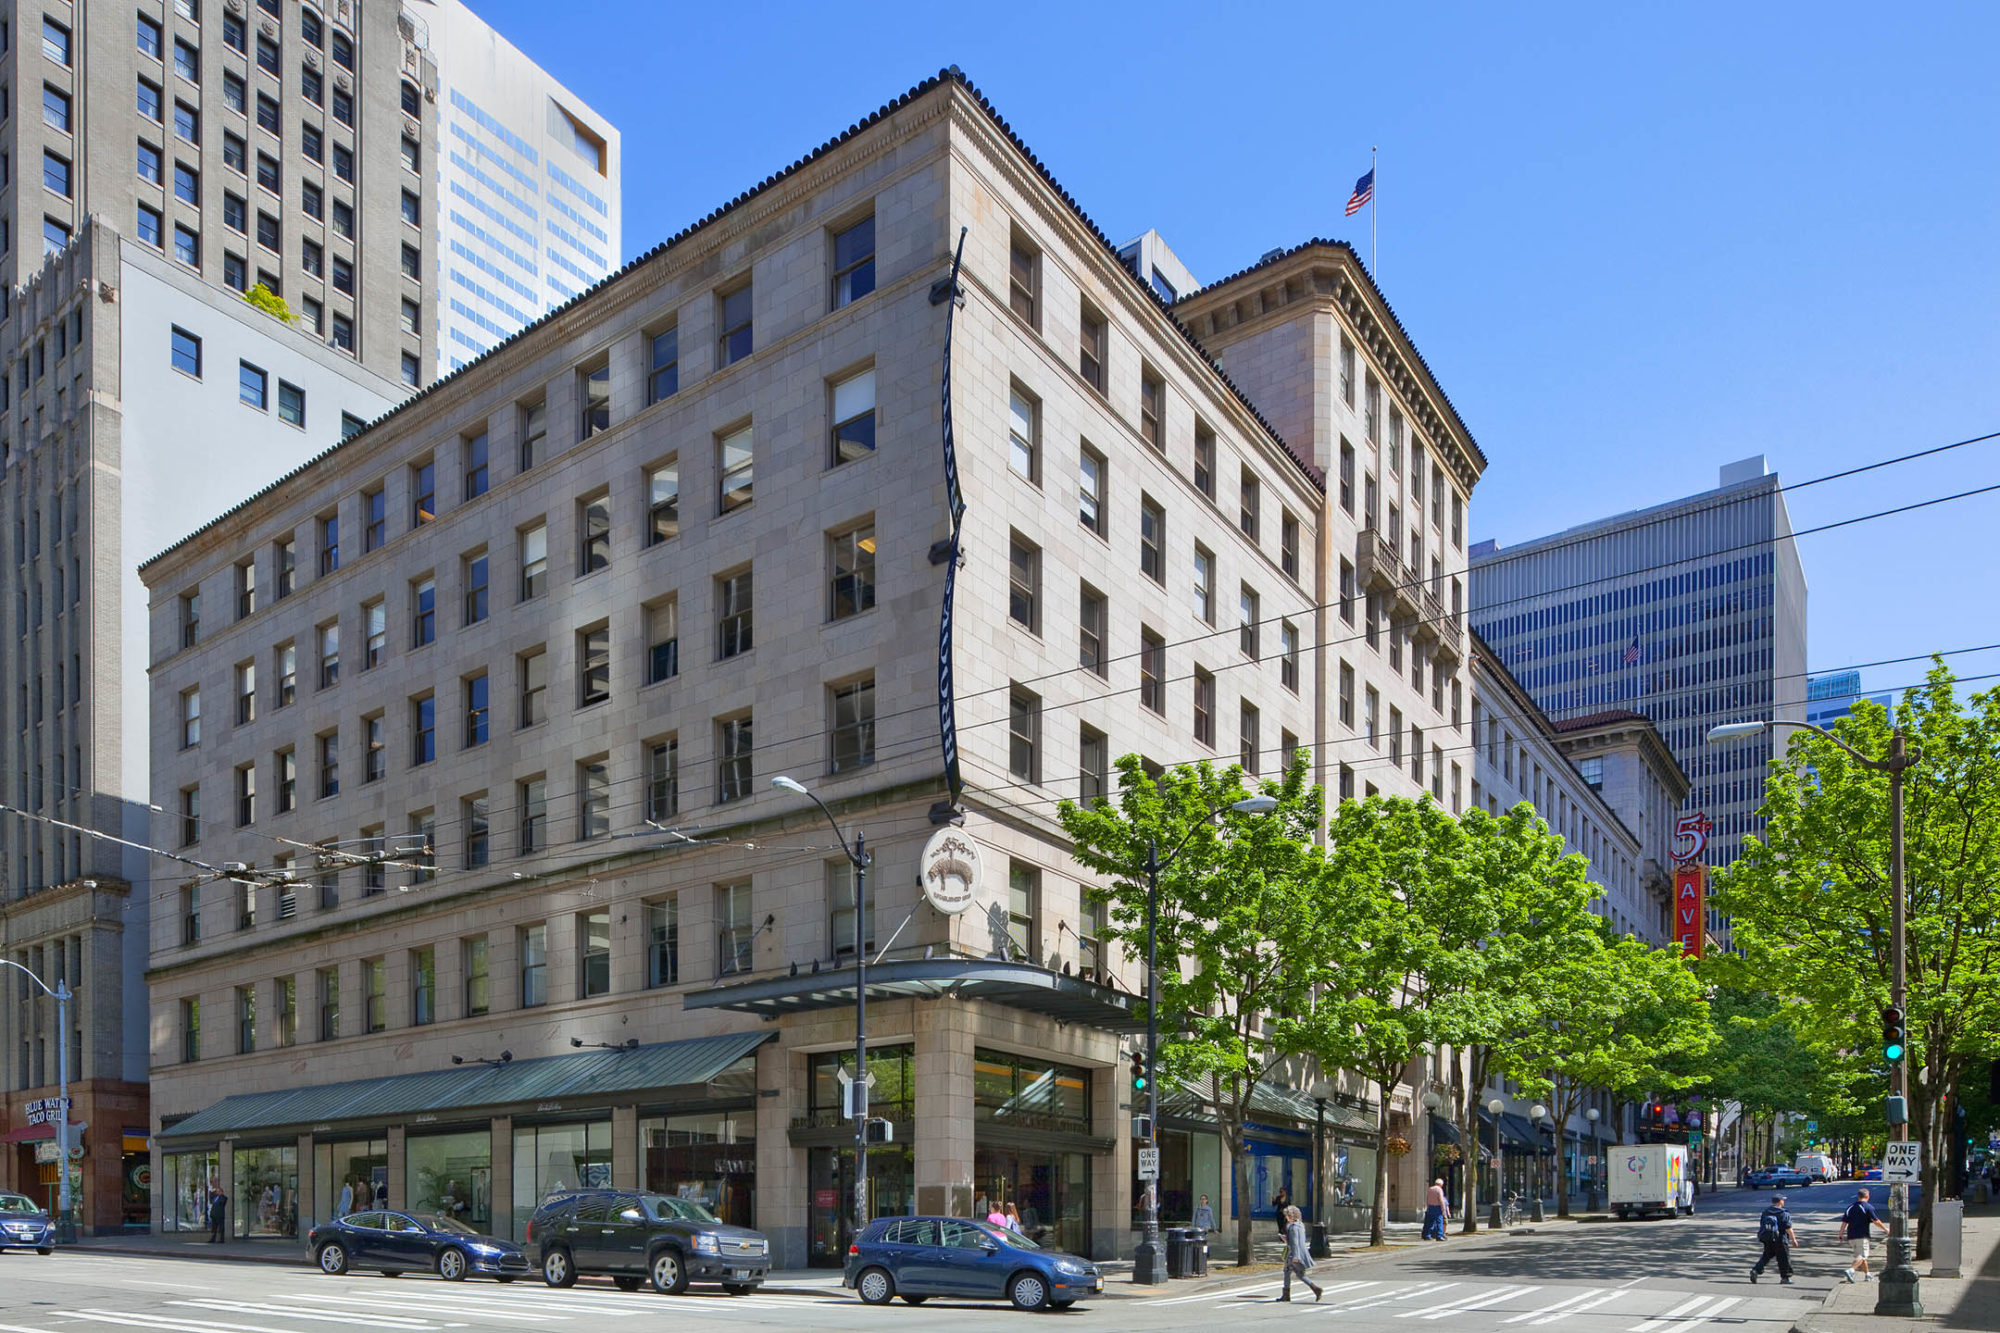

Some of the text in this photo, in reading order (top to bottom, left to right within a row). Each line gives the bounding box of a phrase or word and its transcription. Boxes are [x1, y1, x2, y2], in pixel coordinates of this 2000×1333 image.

[1680, 882, 1696, 950] AVE
[25, 1097, 70, 1114] BLUE WAT
[28, 1110, 62, 1126] TACO GRIL
[1140, 1150, 1156, 1159] ONE
[1889, 1144, 1917, 1155] ONE
[1887, 1156, 1917, 1166] WAY
